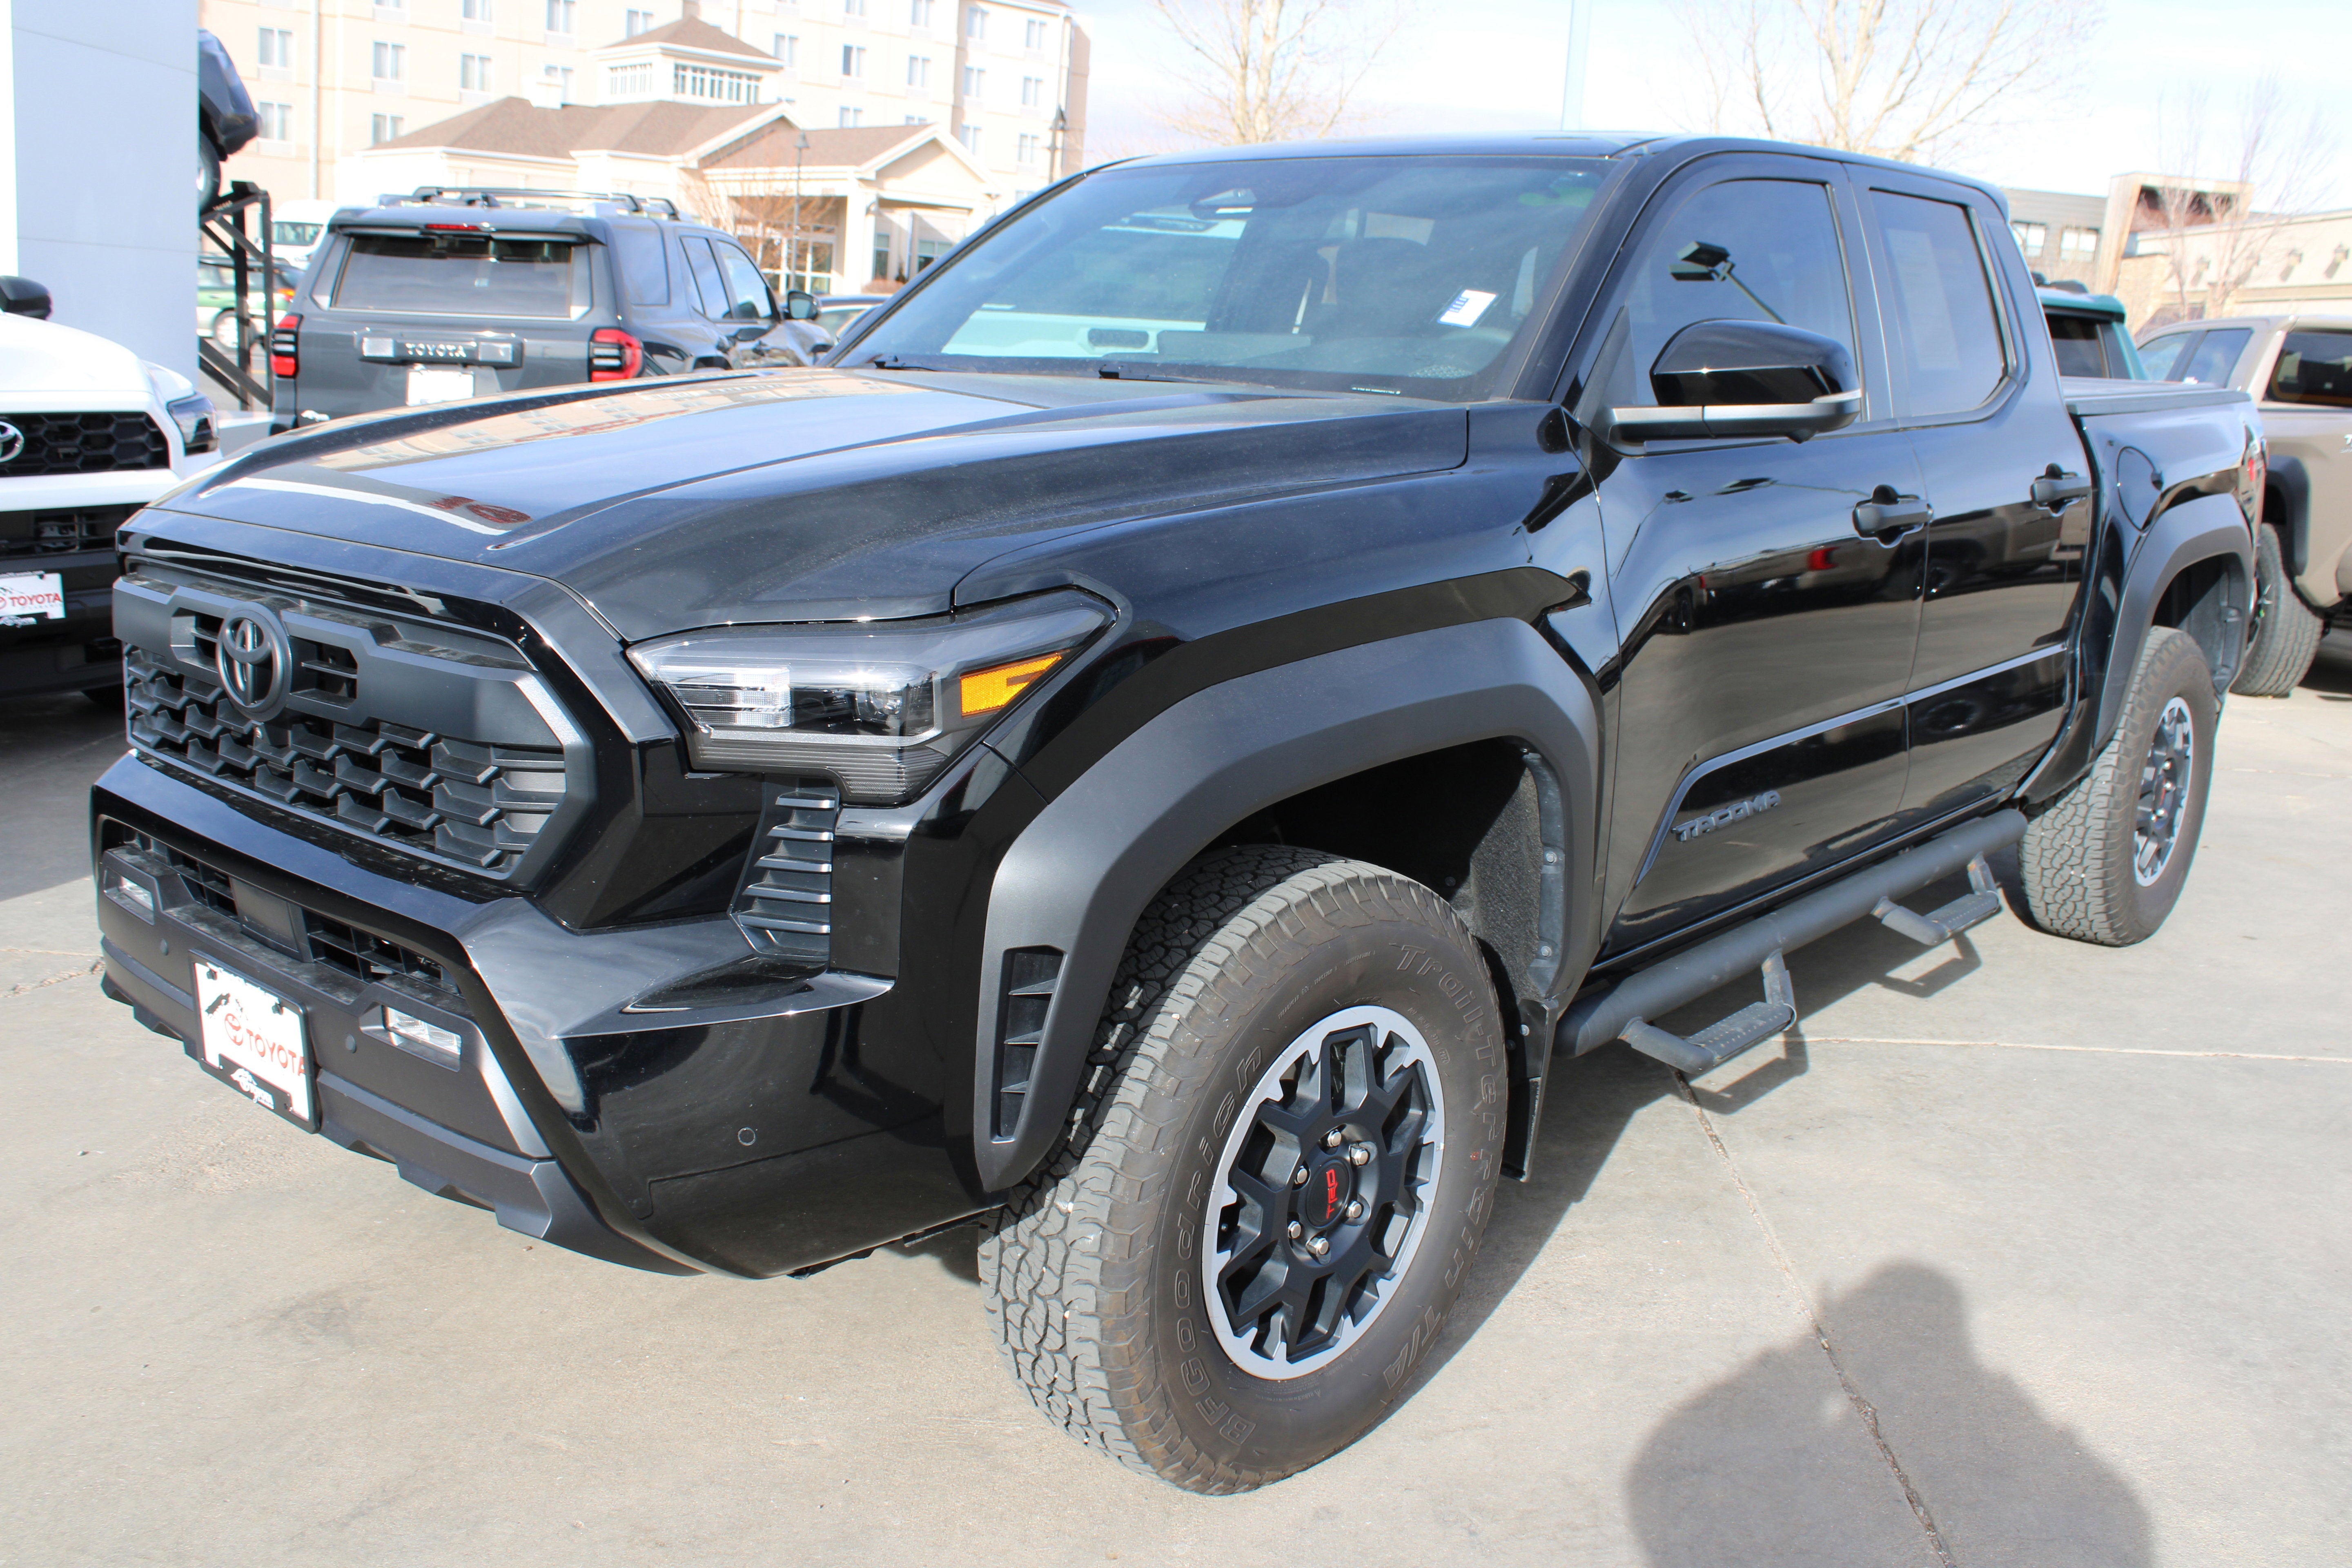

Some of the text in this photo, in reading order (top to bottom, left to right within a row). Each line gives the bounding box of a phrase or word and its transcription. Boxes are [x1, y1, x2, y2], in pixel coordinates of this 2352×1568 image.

[405, 343, 467, 358] TOYOTA
[9, 592, 63, 607] TOYOTA
[1673, 790, 1781, 842] TACOMA
[246, 1028, 305, 1076] TOYOTA
[1325, 1169, 1339, 1219] TRD
[1174, 1046, 1262, 1446] BFGoodrich
[1383, 1305, 1442, 1390] T/A
